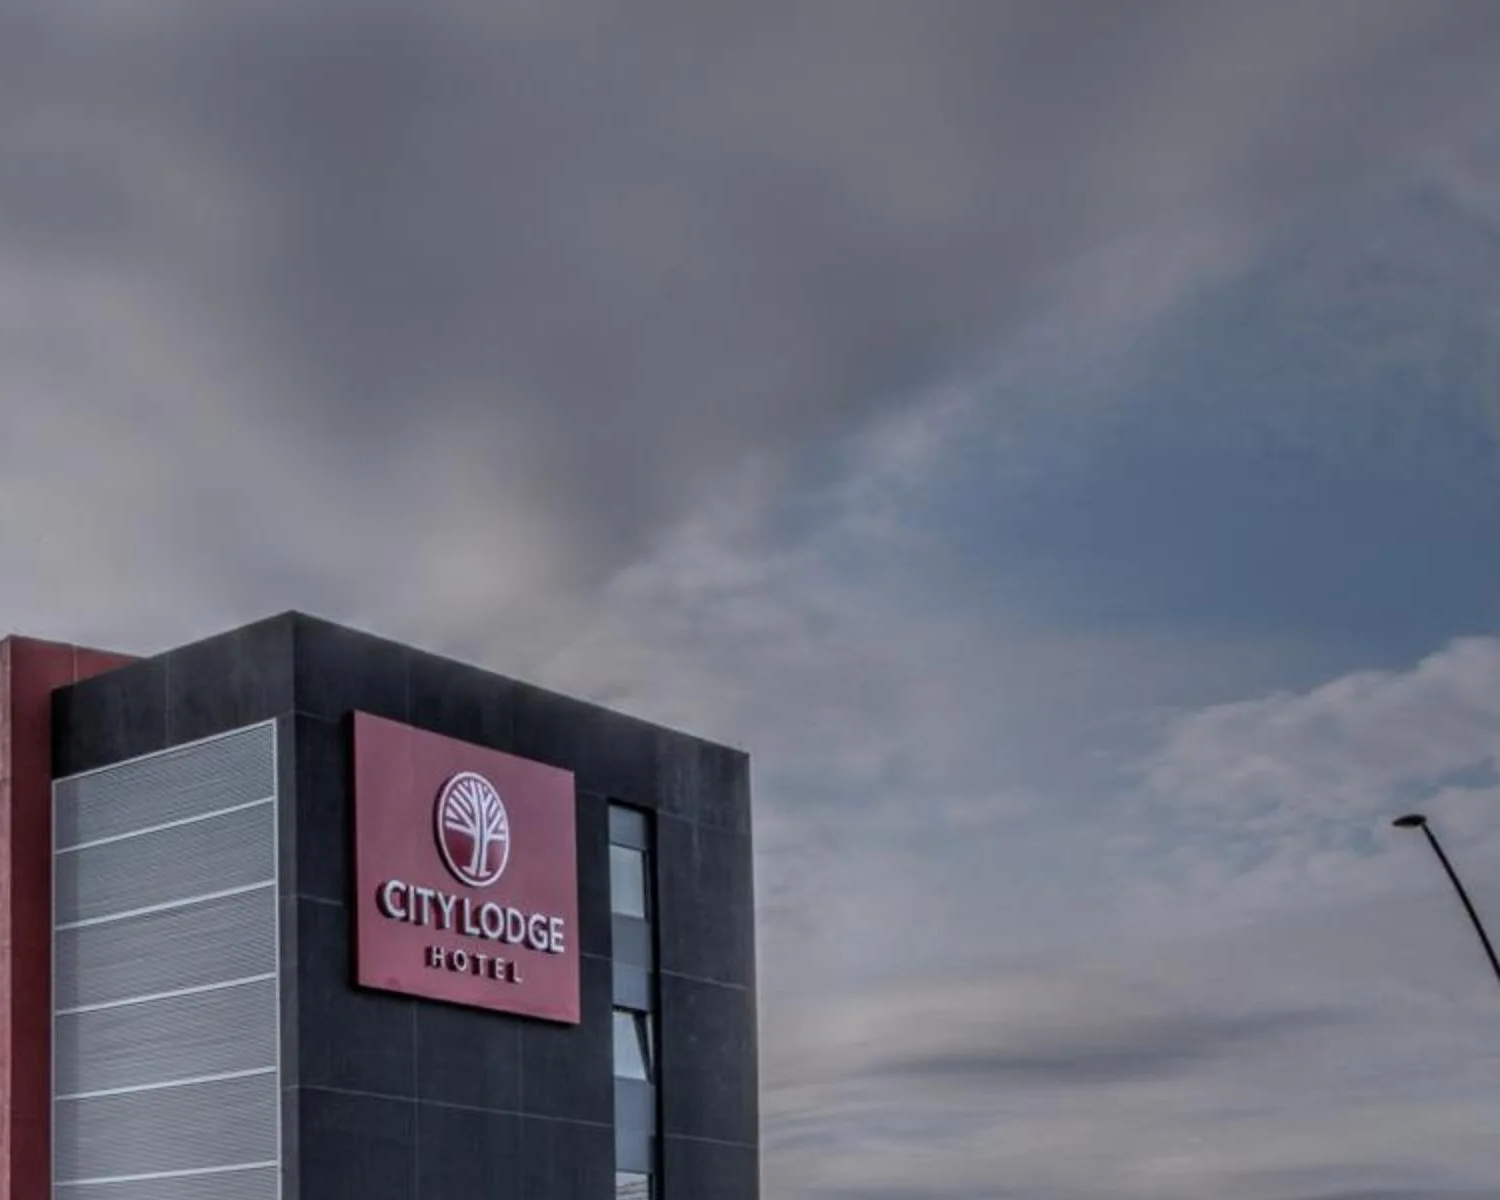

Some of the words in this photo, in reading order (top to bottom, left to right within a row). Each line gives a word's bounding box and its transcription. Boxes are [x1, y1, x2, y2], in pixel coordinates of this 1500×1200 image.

[382, 880, 456, 929] CITY
[463, 898, 565, 953] LODGE
[431, 946, 523, 983] HOTEL
